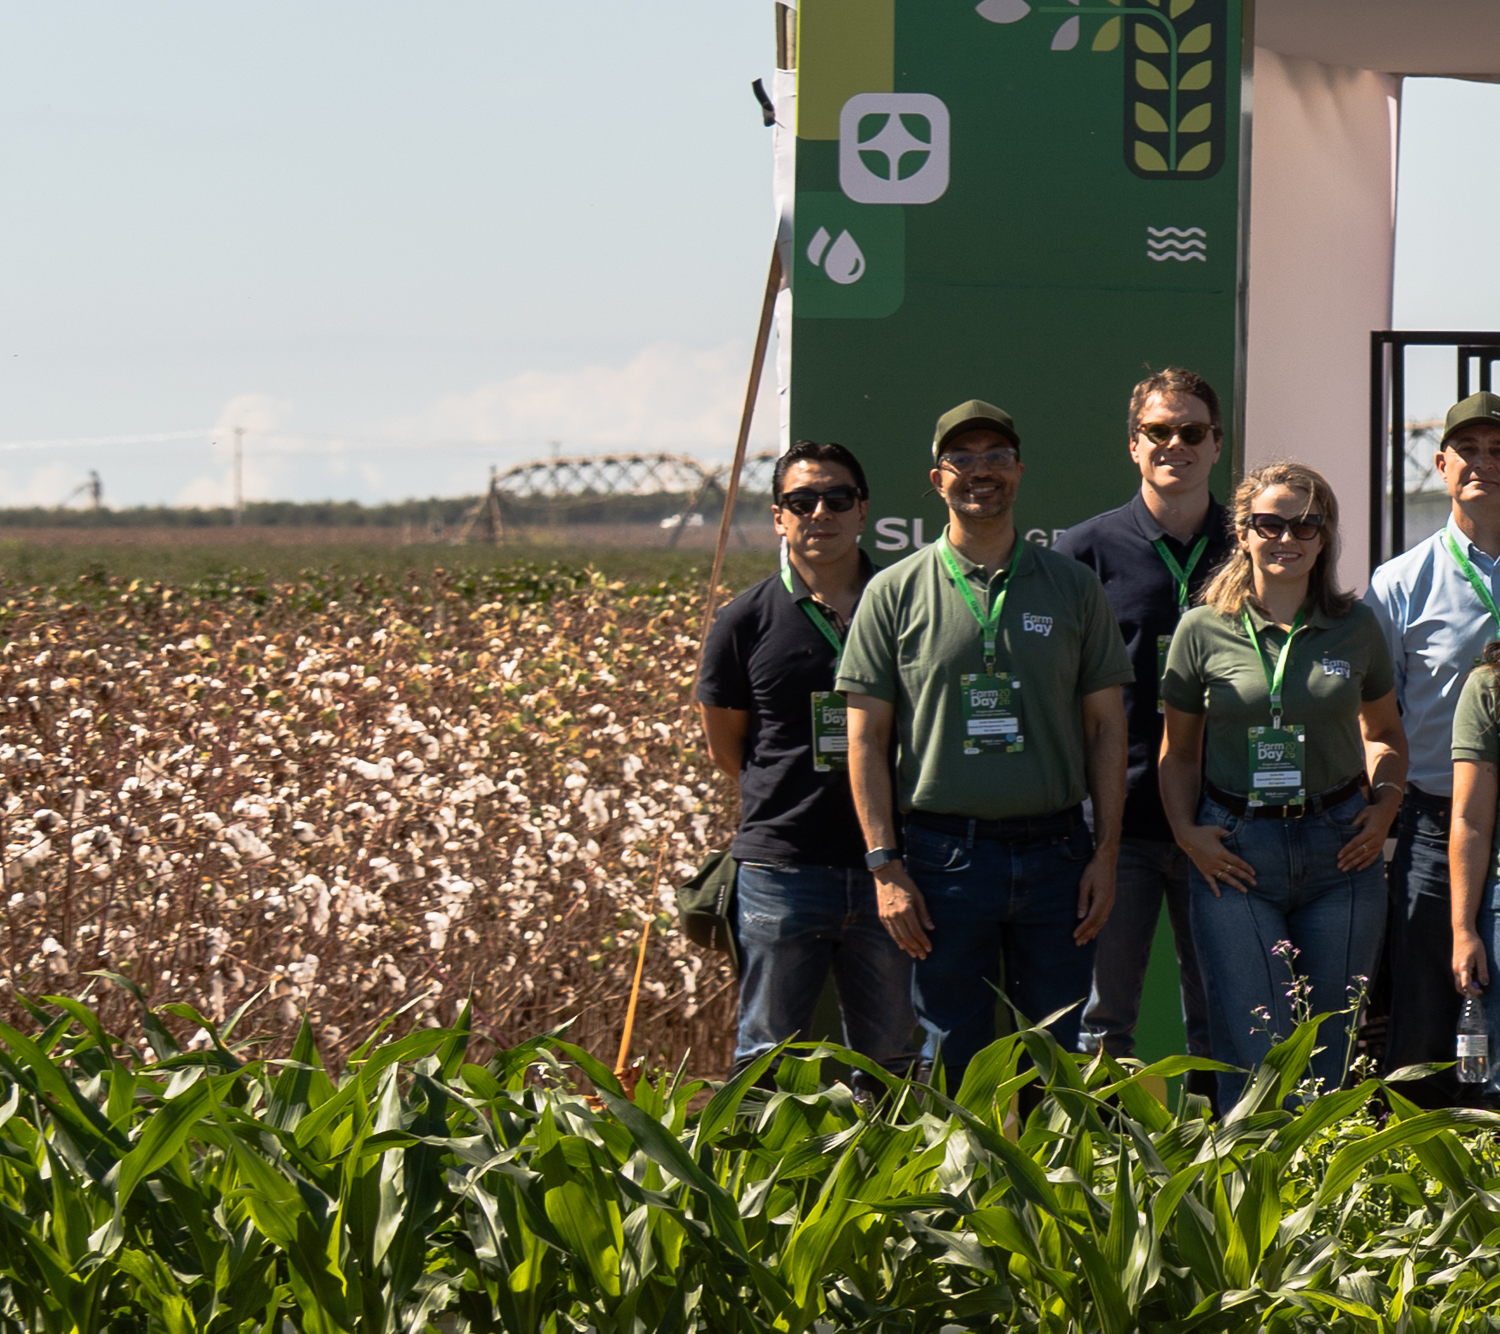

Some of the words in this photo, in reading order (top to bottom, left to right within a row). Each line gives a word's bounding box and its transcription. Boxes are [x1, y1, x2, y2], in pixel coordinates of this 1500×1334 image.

[874, 517, 933, 551] SL
[1023, 613, 1053, 623] Farm
[1024, 621, 1052, 636] Day
[970, 689, 998, 698] Farm
[970, 697, 994, 709] Day
[1258, 742, 1284, 750] Farm
[1258, 749, 1280, 761] Day
